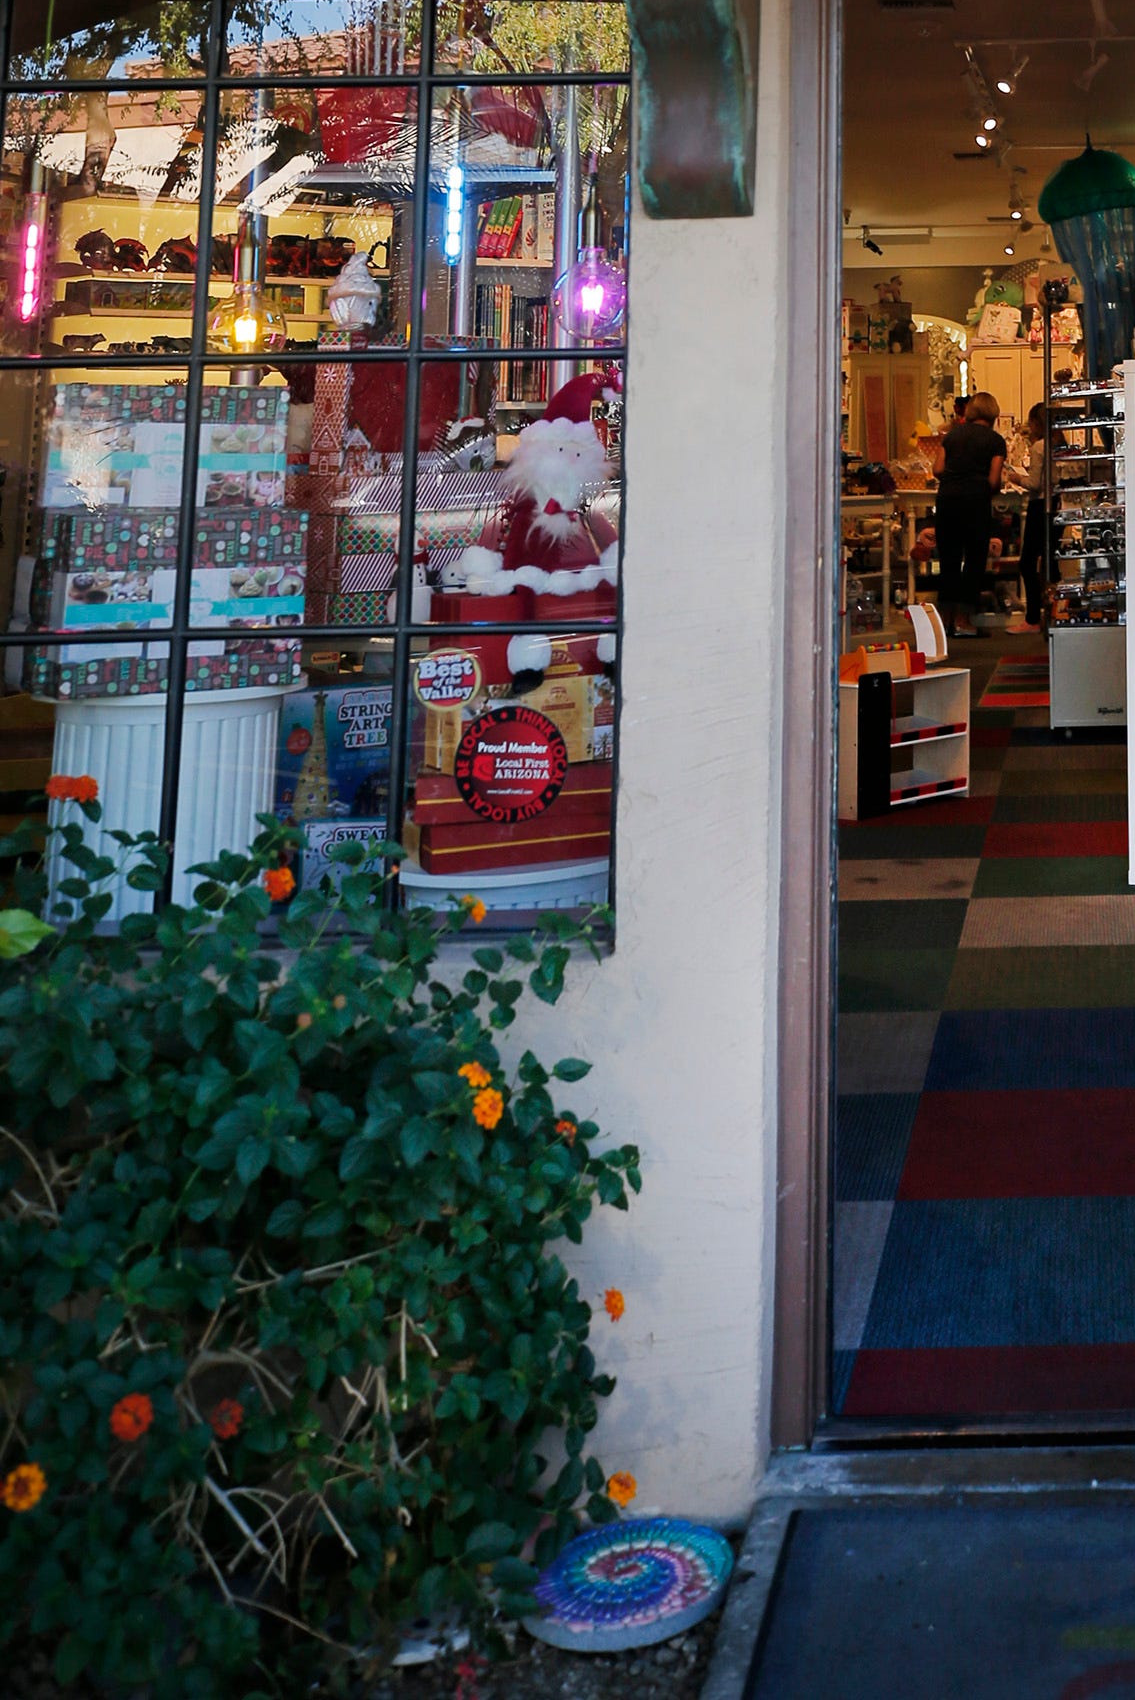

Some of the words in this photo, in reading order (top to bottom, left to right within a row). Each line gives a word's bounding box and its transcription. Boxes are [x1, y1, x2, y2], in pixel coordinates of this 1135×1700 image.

[419, 659, 473, 679] Best
[432, 676, 445, 689] of
[445, 676, 462, 685] the
[420, 685, 473, 700] Valley
[340, 701, 393, 720] STRING
[350, 716, 382, 731] ART
[345, 729, 387, 747] TREE
[462, 713, 497, 756] LOCAL
[477, 741, 507, 754] Proud
[508, 741, 549, 754] Member
[515, 707, 555, 736] THINK
[551, 734, 568, 785] LOCAL
[456, 759, 471, 778] BE
[495, 758, 523, 769] Local
[524, 758, 550, 769] First
[494, 769, 550, 780] ARIZONA
[471, 792, 511, 821] LOCAL
[516, 800, 546, 821] BUY
